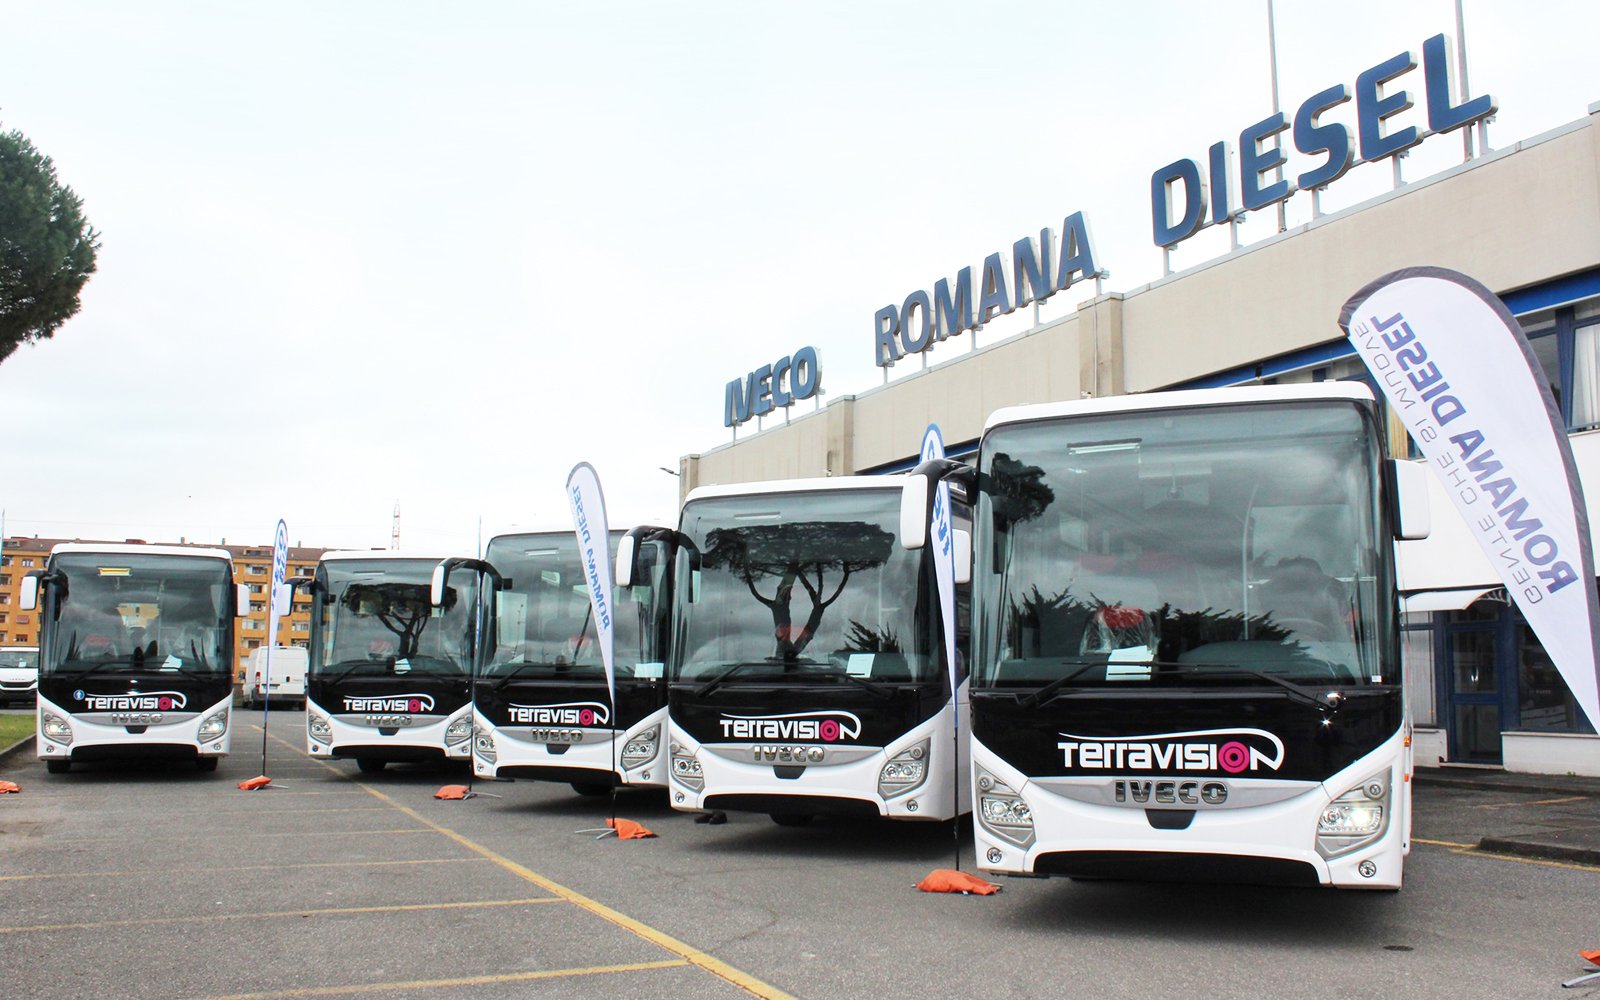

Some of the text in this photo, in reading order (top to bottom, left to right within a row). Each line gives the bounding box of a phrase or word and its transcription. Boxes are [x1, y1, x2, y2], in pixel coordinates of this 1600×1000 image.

[724, 33, 1500, 427] IVECO ROMANA DIESEL
[112, 713, 163, 724] IVECO
[365, 714, 413, 726] IVECO
[531, 728, 583, 742] IVECO
[754, 746, 825, 763] IVECO
[1115, 780, 1229, 805] IVECO
